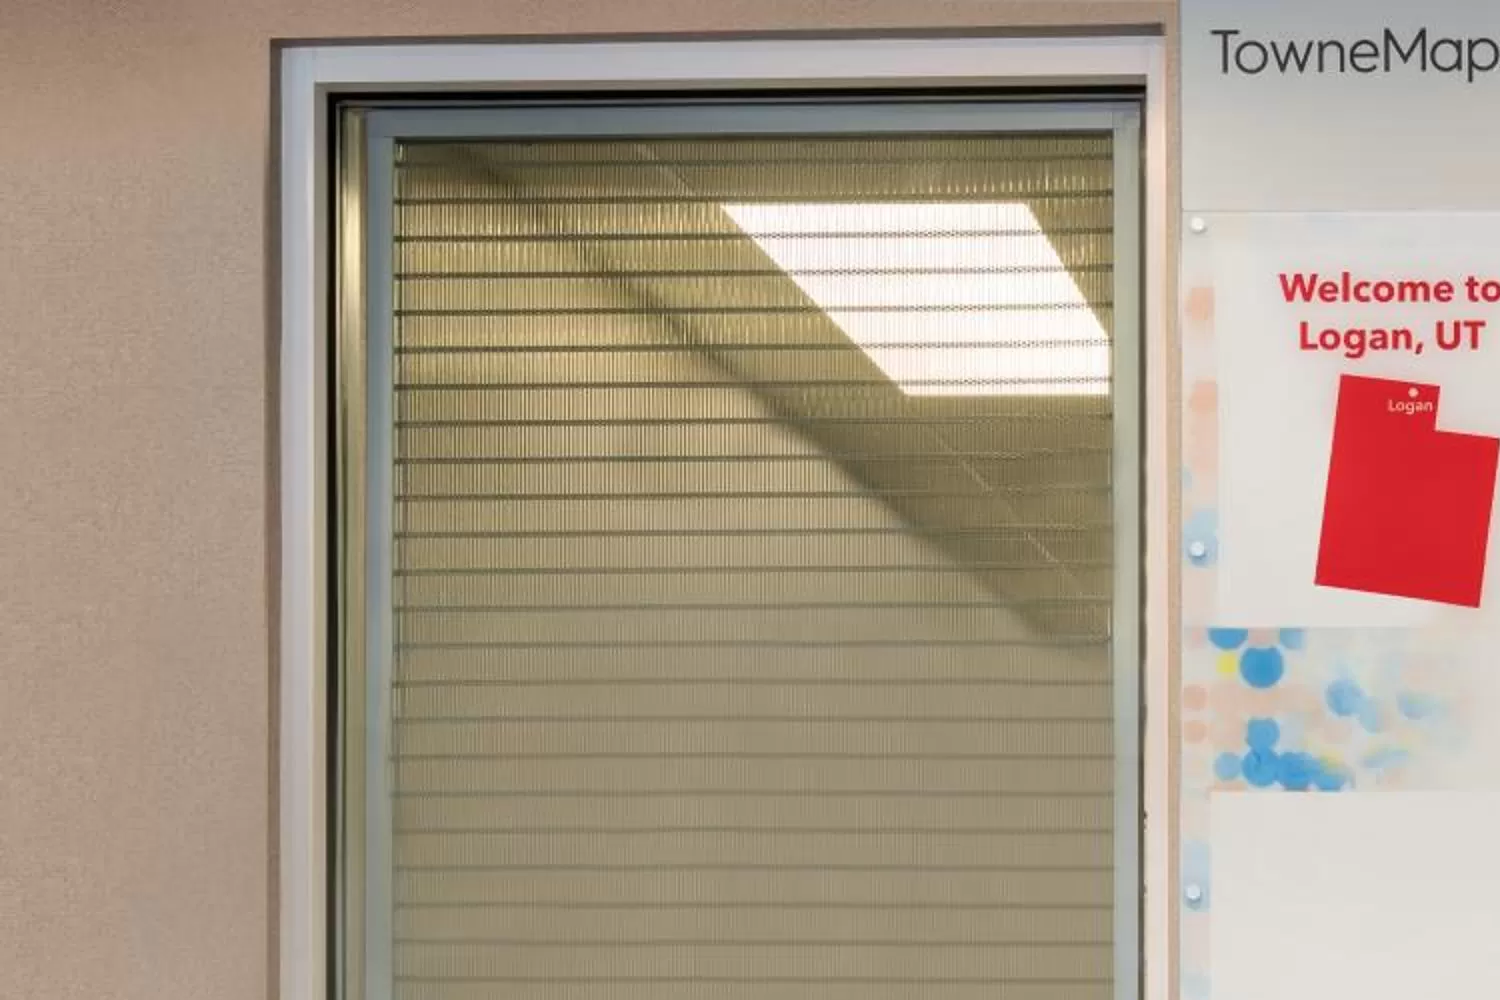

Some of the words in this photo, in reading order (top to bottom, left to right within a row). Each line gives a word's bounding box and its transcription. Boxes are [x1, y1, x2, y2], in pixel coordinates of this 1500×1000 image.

[1278, 272, 1454, 303] Welcome
[1299, 321, 1424, 358] Logan,
[1435, 321, 1486, 350] UT
[1388, 398, 1433, 414] Logan
